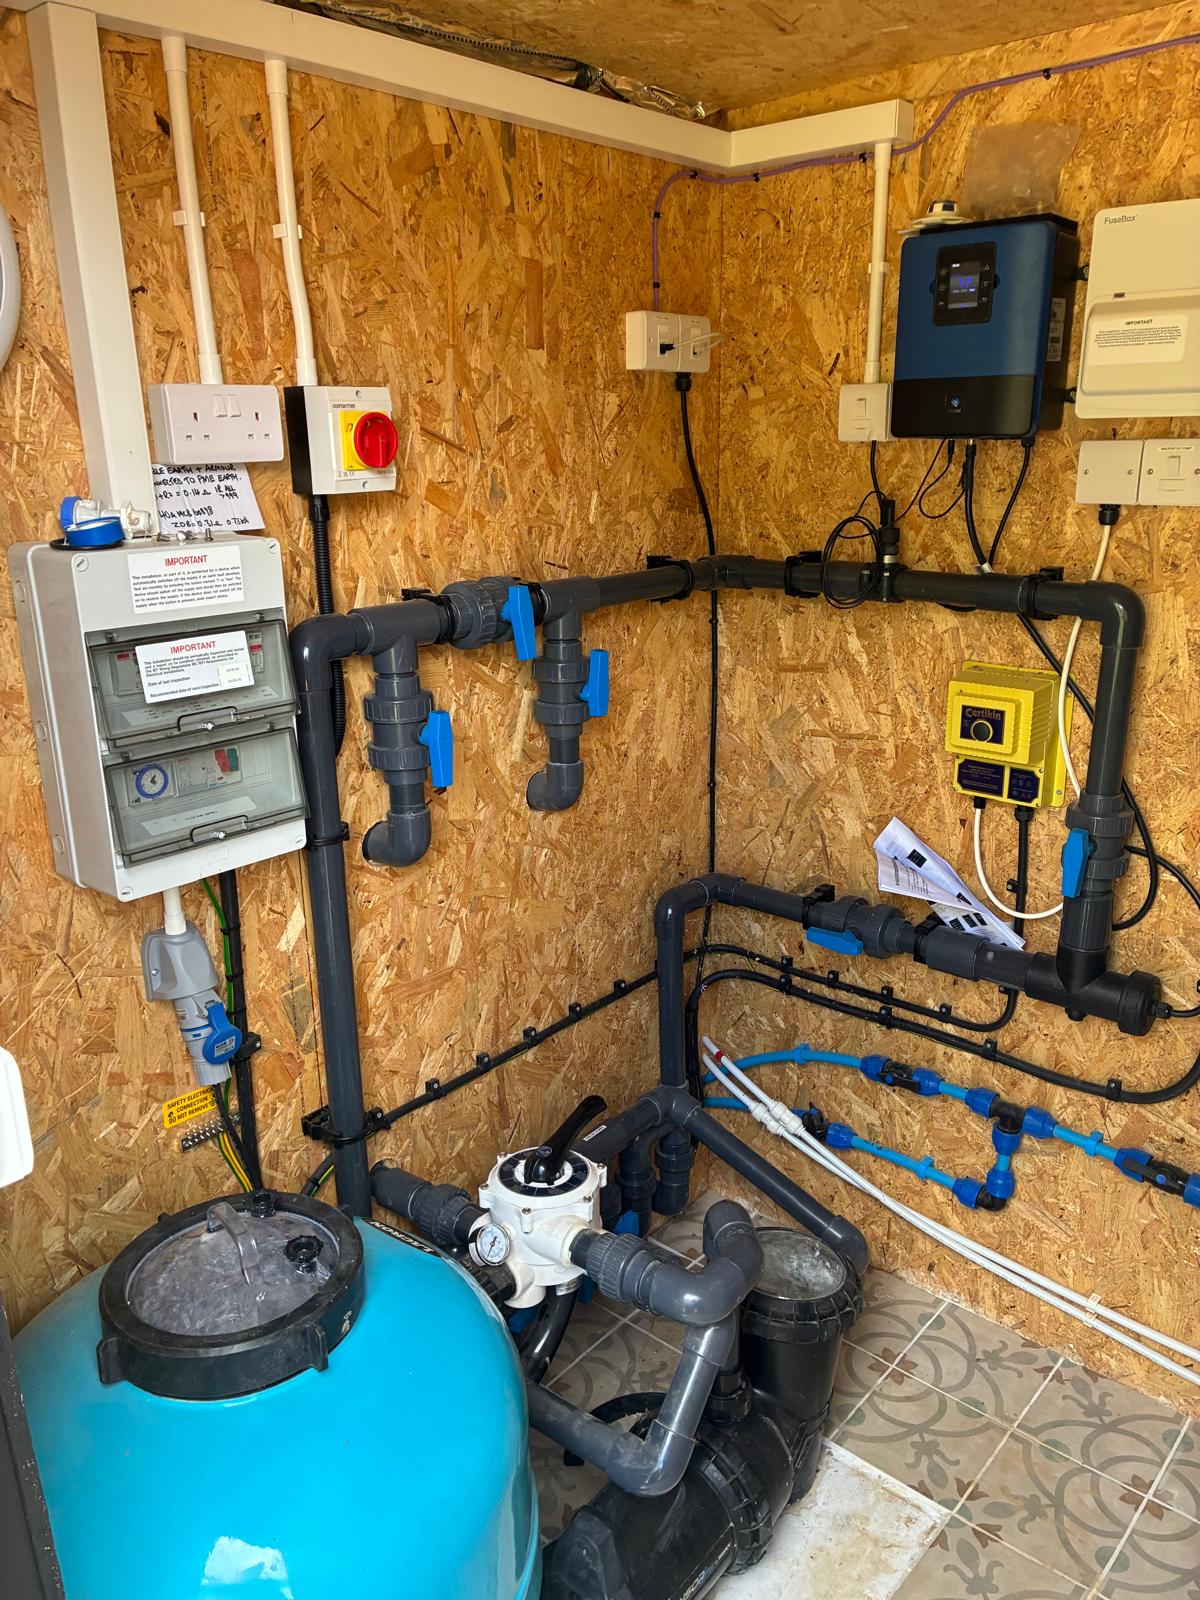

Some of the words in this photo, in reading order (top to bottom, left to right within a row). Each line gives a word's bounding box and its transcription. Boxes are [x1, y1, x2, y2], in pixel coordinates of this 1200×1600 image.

[1104, 215, 1136, 224] FuseBox
[167, 465, 194, 474] EARTH
[205, 463, 236, 472] ARMOUR
[183, 476, 195, 485] TO
[196, 474, 215, 484] PME
[164, 555, 208, 567] IMPORTANT
[170, 641, 216, 654] IMPORTANT
[150, 690, 178, 698] Recommended
[965, 707, 1001, 721] Certikin
[167, 1098, 186, 1110] SAFETY
[176, 1096, 208, 1113] CONNECTION
[177, 1111, 187, 1120] NOT
[188, 1104, 208, 1115] REMOVE
